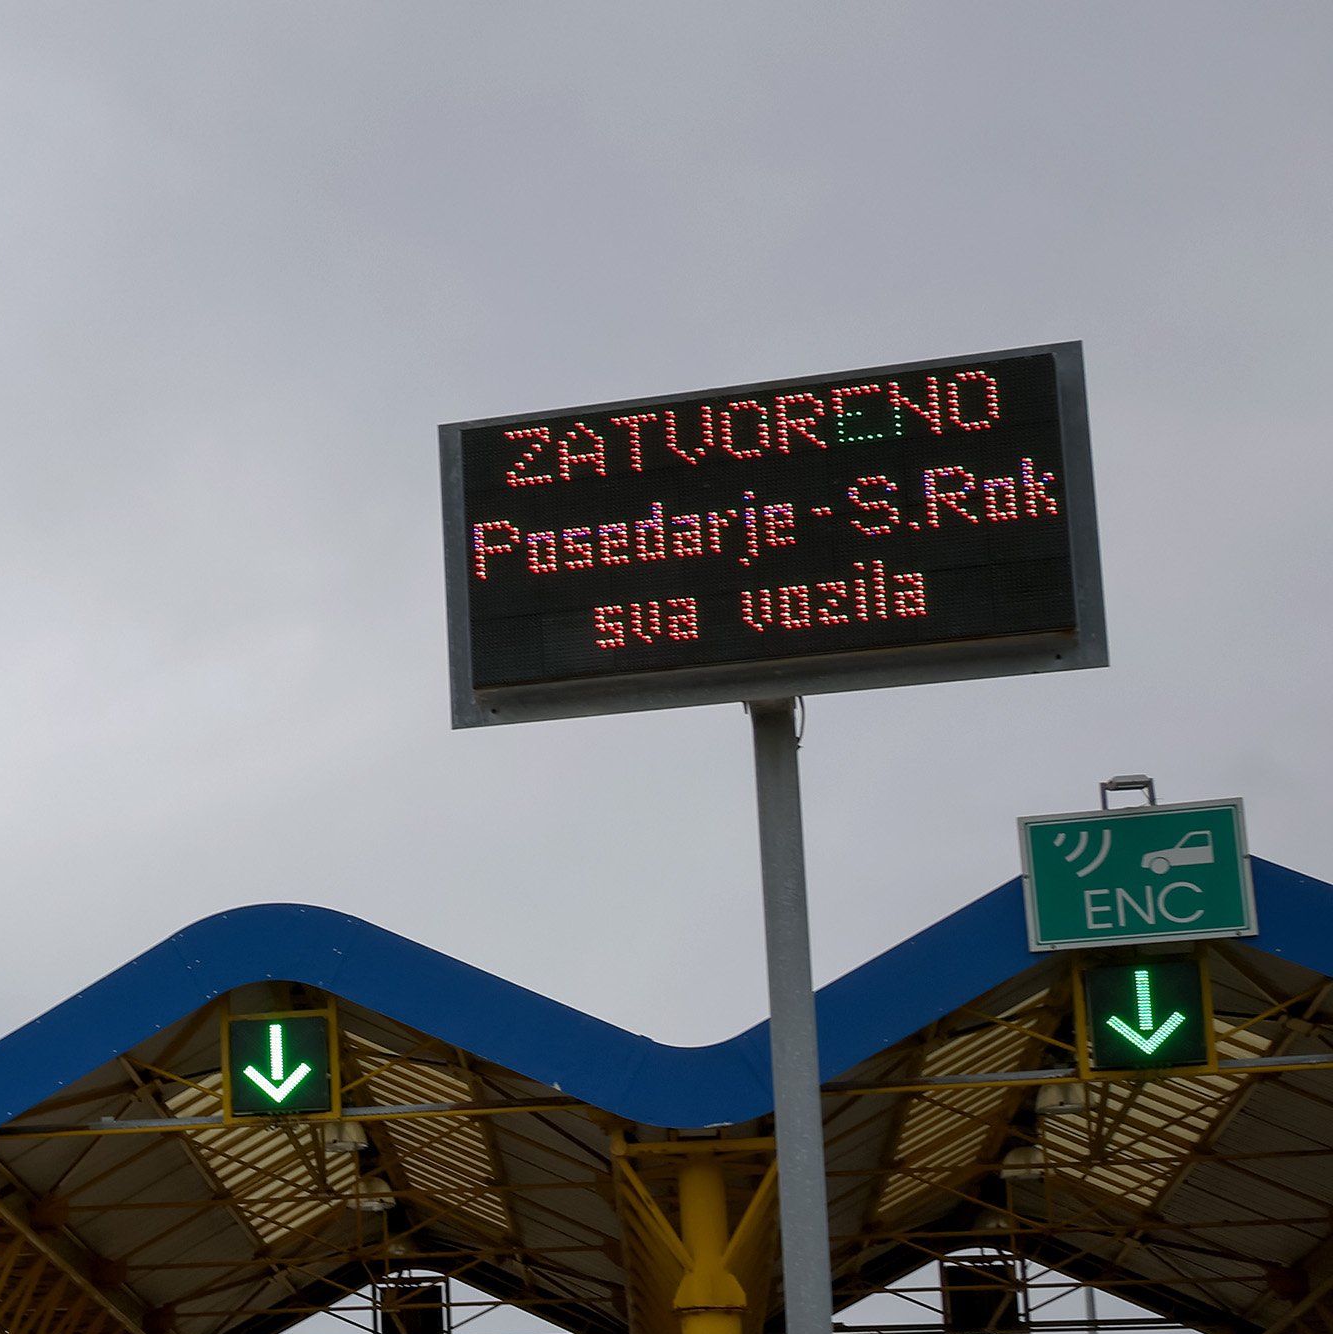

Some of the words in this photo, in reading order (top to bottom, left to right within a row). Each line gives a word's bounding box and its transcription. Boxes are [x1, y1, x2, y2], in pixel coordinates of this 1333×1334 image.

[503, 370, 1001, 488] ZATVORENO
[473, 489, 797, 581] Posedarje
[846, 457, 1059, 537] S.Rok
[594, 597, 700, 650] sva
[741, 559, 928, 633] vozila
[1082, 881, 1205, 930] ENC
